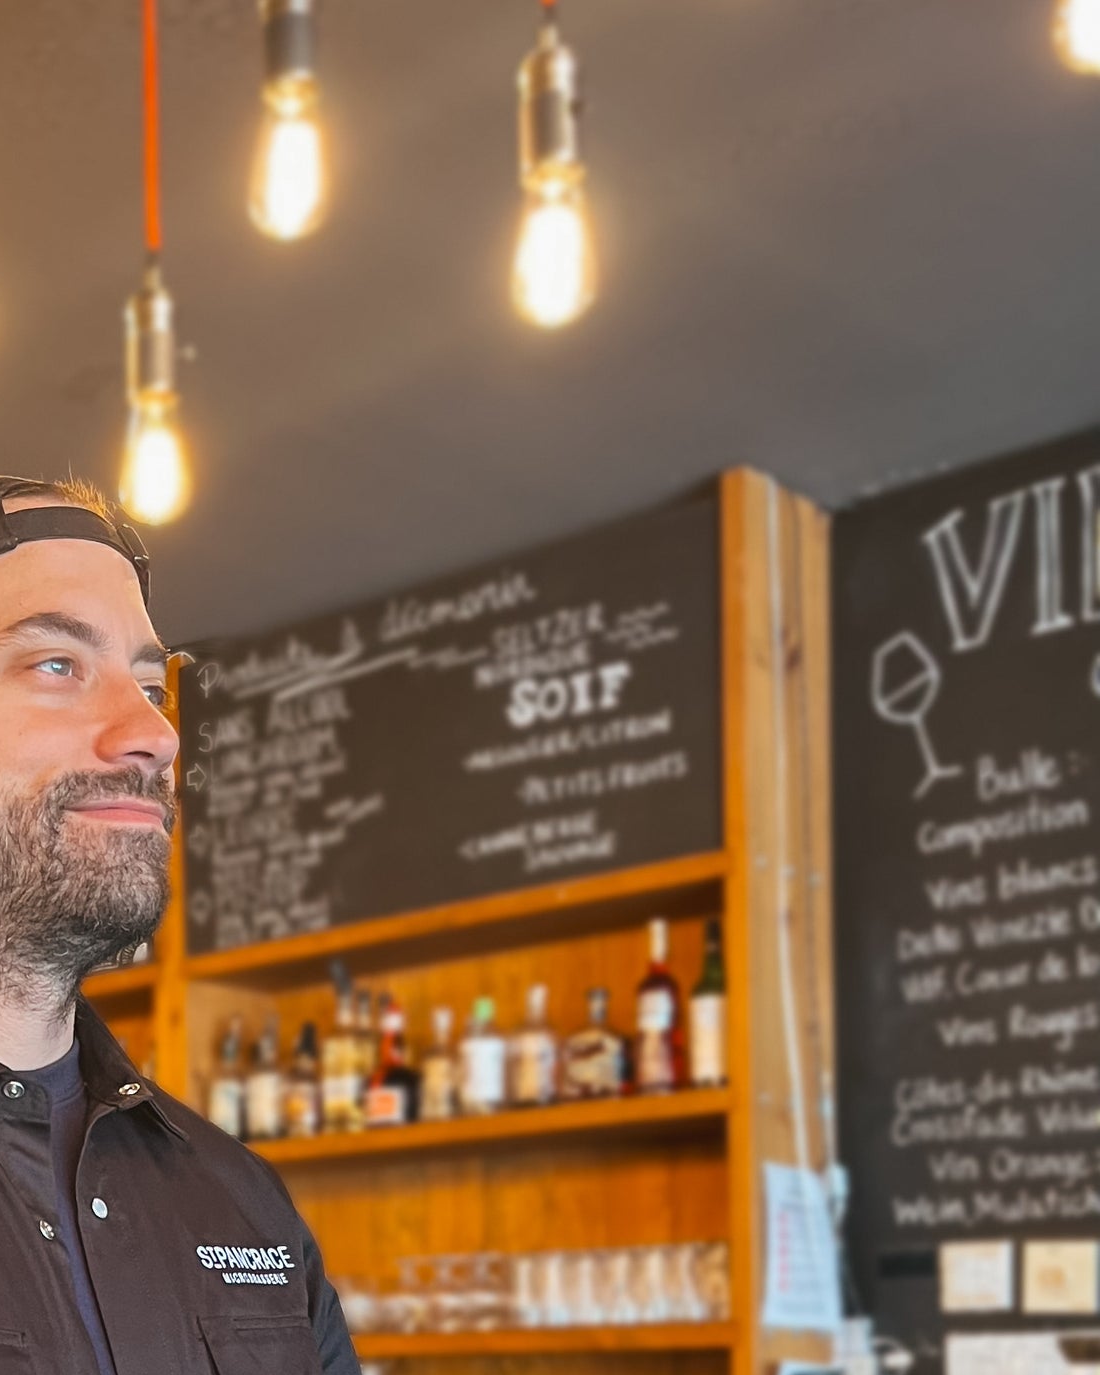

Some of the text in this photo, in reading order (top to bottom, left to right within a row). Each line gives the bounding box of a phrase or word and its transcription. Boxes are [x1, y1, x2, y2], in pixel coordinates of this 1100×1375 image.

[505, 660, 632, 728] SOIF
[924, 875, 987, 911] Vins
[934, 1015, 998, 1048] Vins
[927, 1149, 981, 1183] Vin
